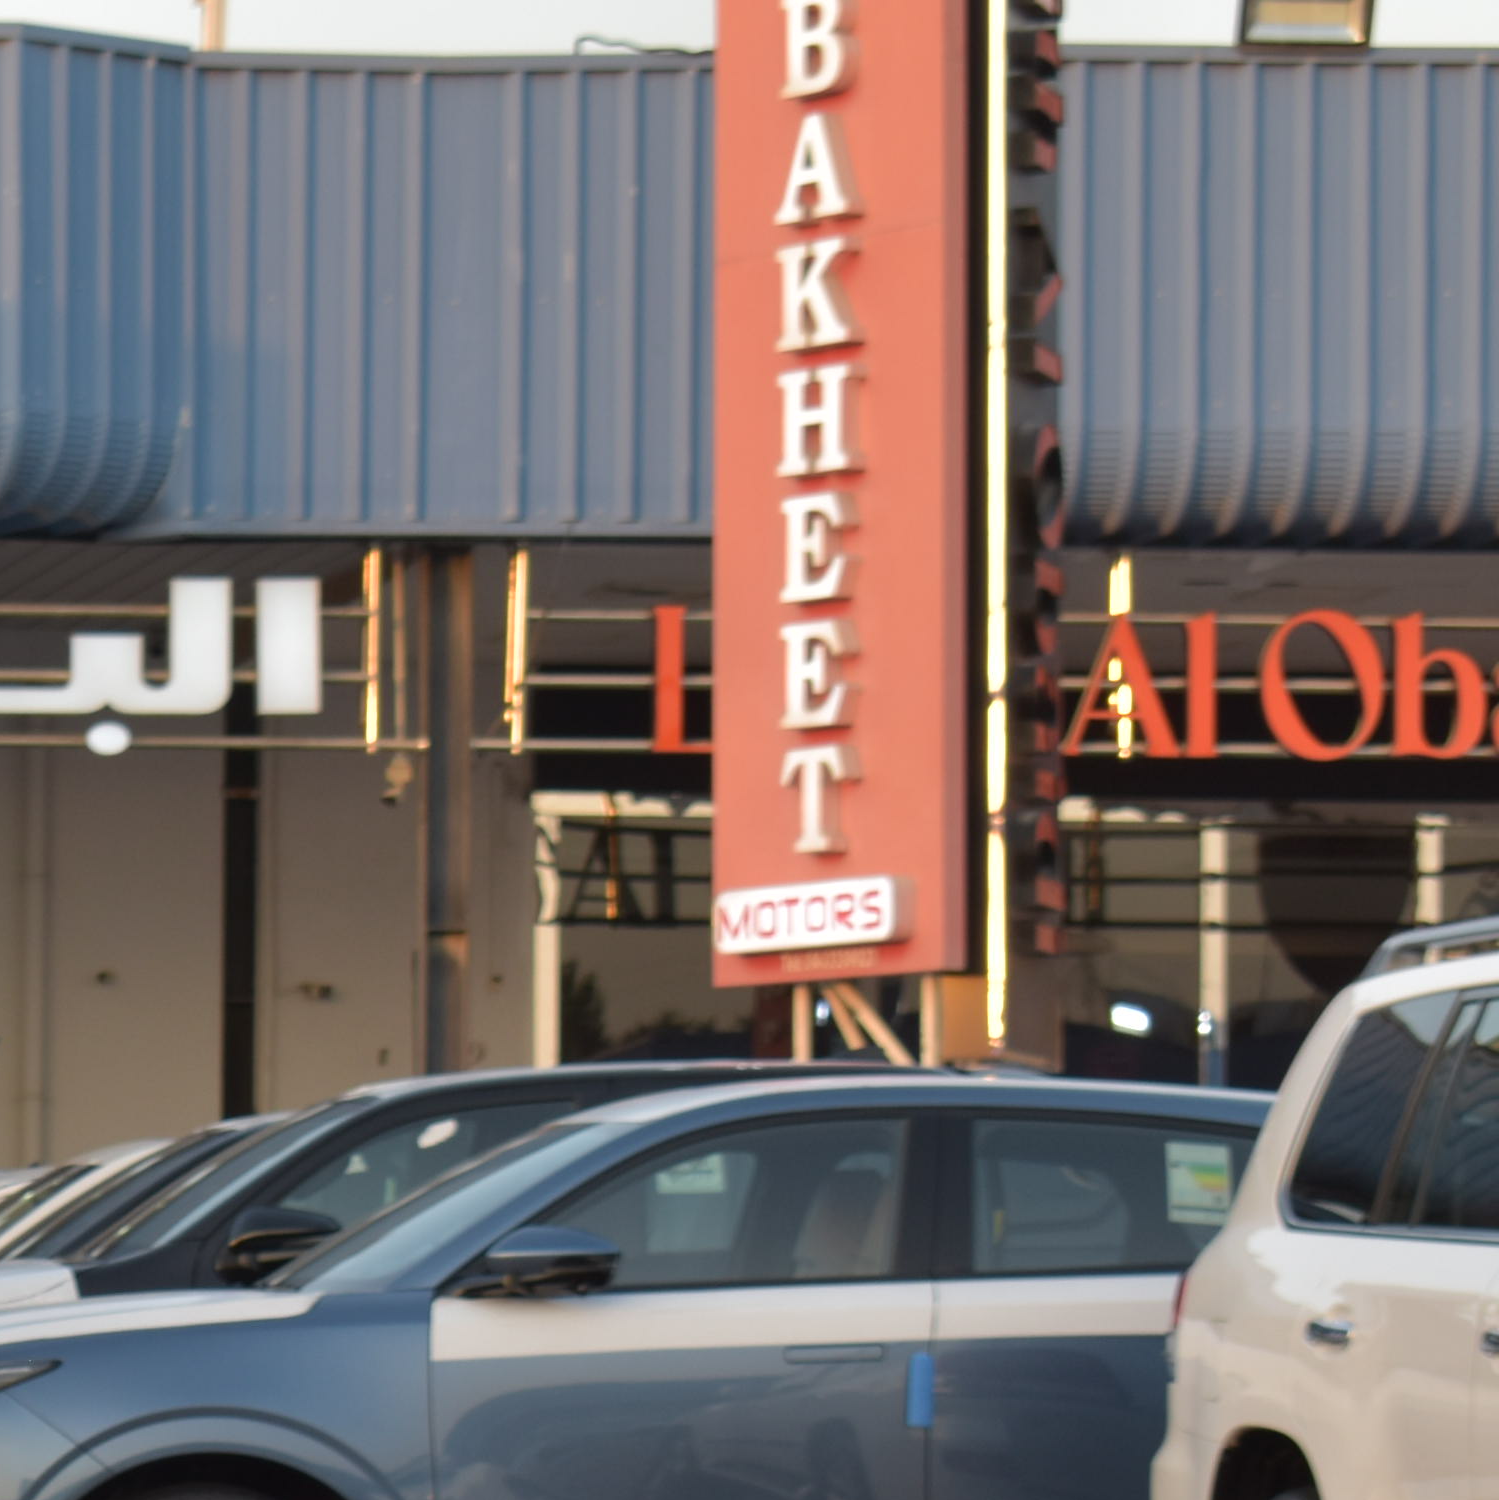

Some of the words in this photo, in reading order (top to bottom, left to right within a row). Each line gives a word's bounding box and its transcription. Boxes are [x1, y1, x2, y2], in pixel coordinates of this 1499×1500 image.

[774, 0, 861, 855] BAKHEET
[1060, 612, 1218, 759] Al
[1259, 608, 1499, 762] Ob
[716, 889, 883, 943] MOTORS
